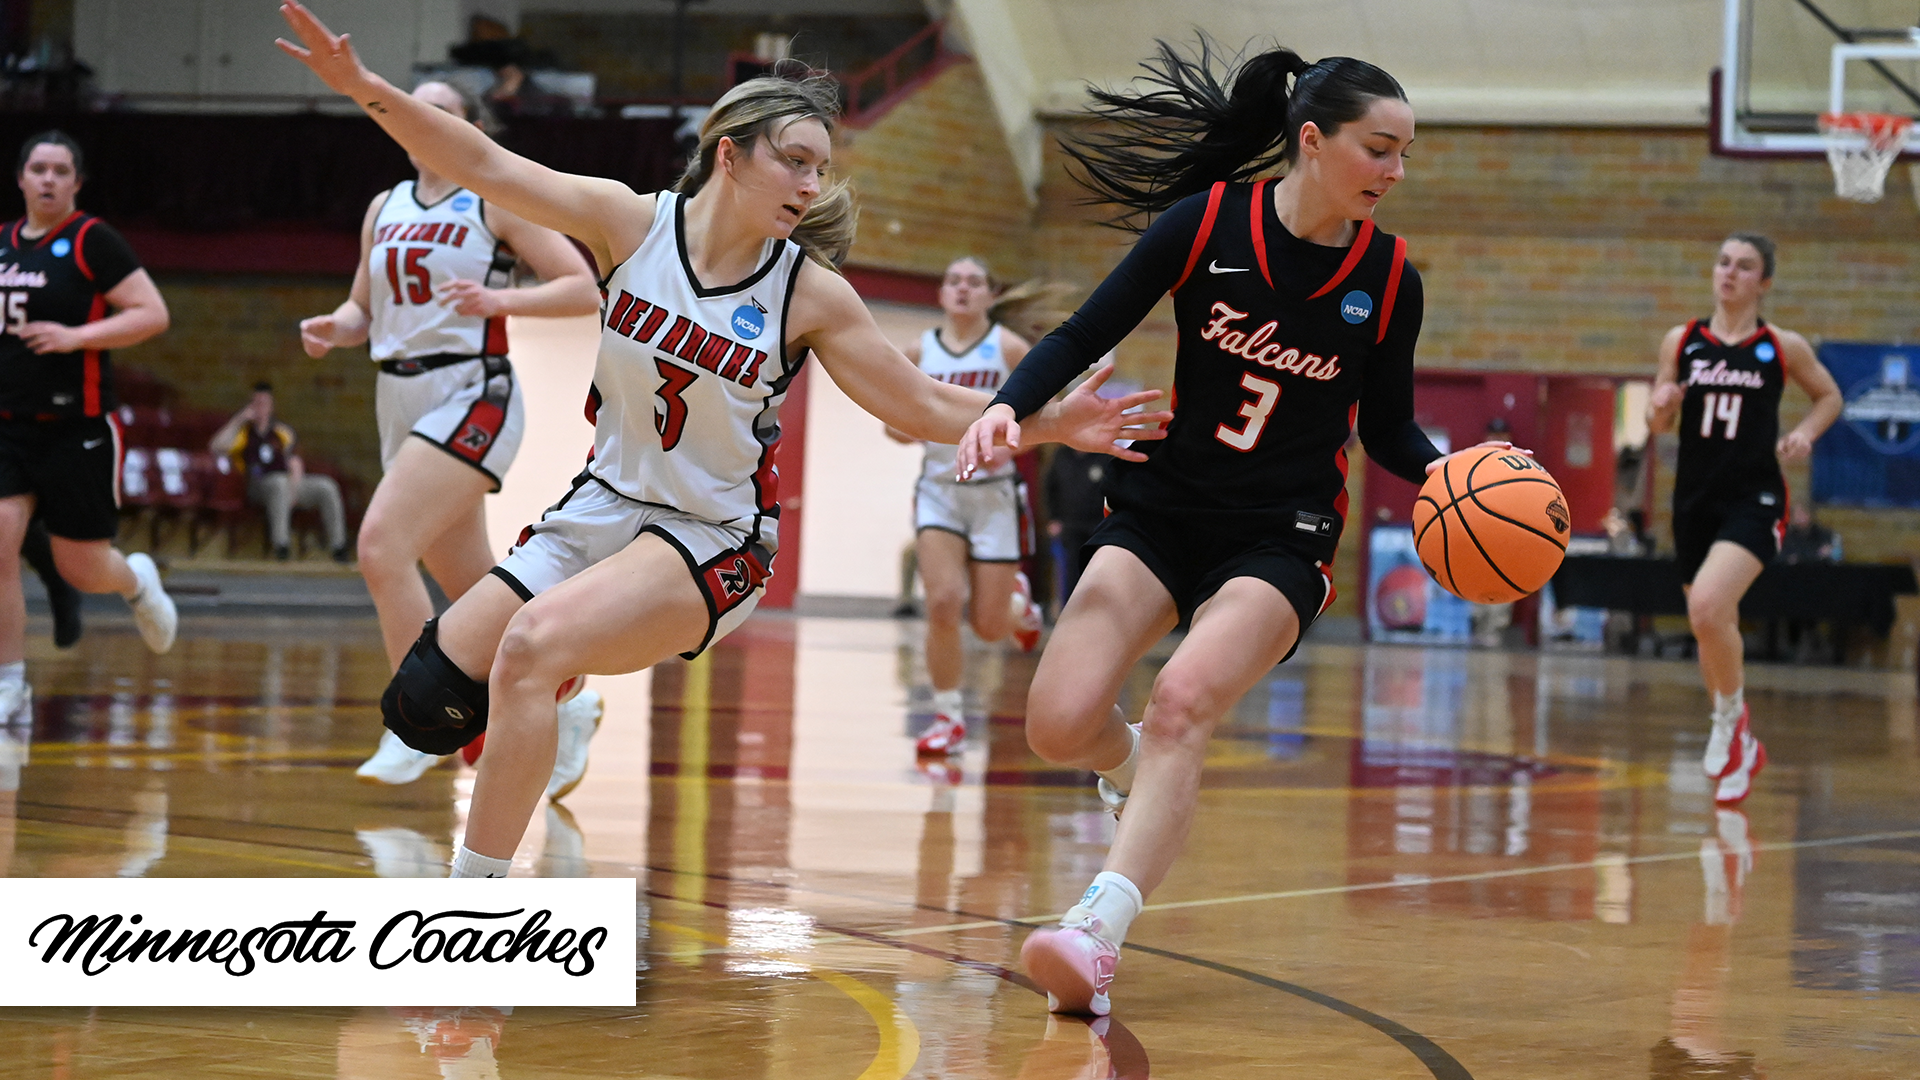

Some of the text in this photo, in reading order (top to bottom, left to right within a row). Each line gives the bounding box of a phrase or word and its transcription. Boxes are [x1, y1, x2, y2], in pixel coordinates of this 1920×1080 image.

[386, 247, 434, 306] 15
[734, 316, 761, 336] NCAA
[1343, 304, 1370, 319] NCAA
[606, 289, 768, 388] RED HAWKS
[1200, 301, 1342, 380] Falcons
[1687, 358, 1765, 389] Falcons
[653, 356, 699, 452] 3
[1214, 371, 1283, 452] 3
[1700, 392, 1743, 440] 14
[1321, 521, 1330, 531] M
